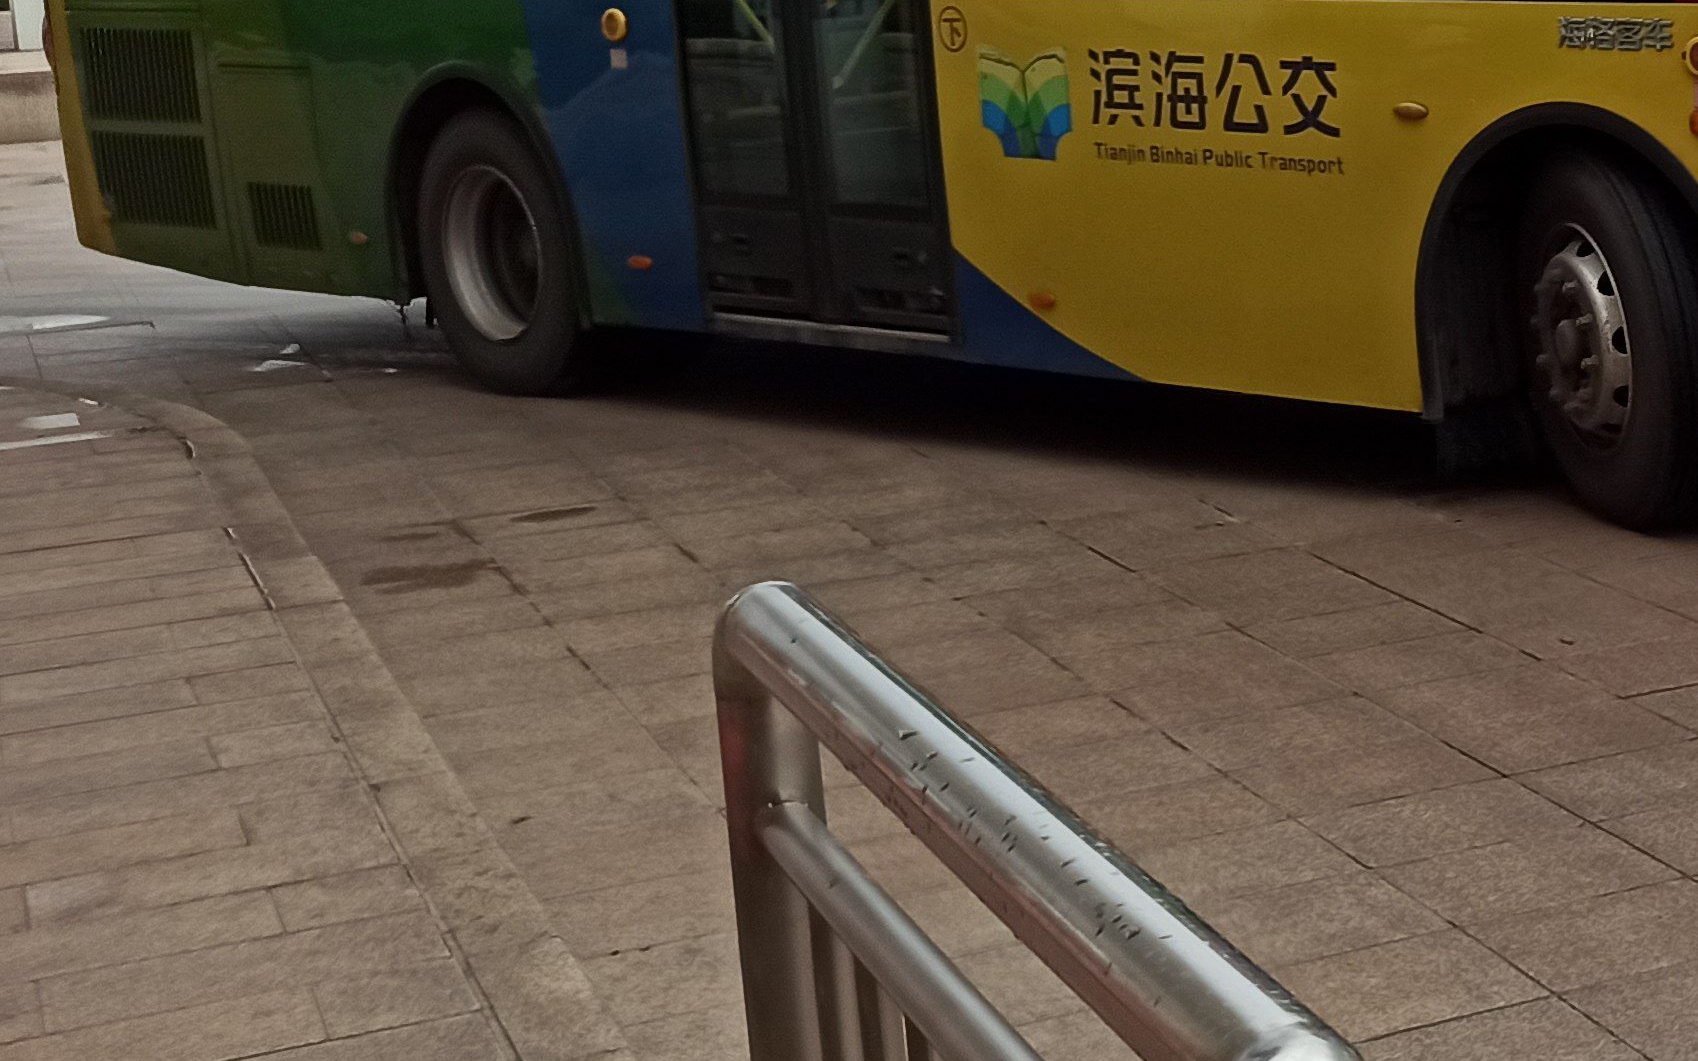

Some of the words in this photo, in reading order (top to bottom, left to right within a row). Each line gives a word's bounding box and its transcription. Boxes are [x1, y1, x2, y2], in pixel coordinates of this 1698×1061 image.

[1088, 48, 1341, 138] 滨海公交
[1093, 142, 1146, 165] Tianjin
[1149, 145, 1199, 166] Binhai
[1202, 148, 1254, 169] Public
[1257, 151, 1345, 176] Transport
